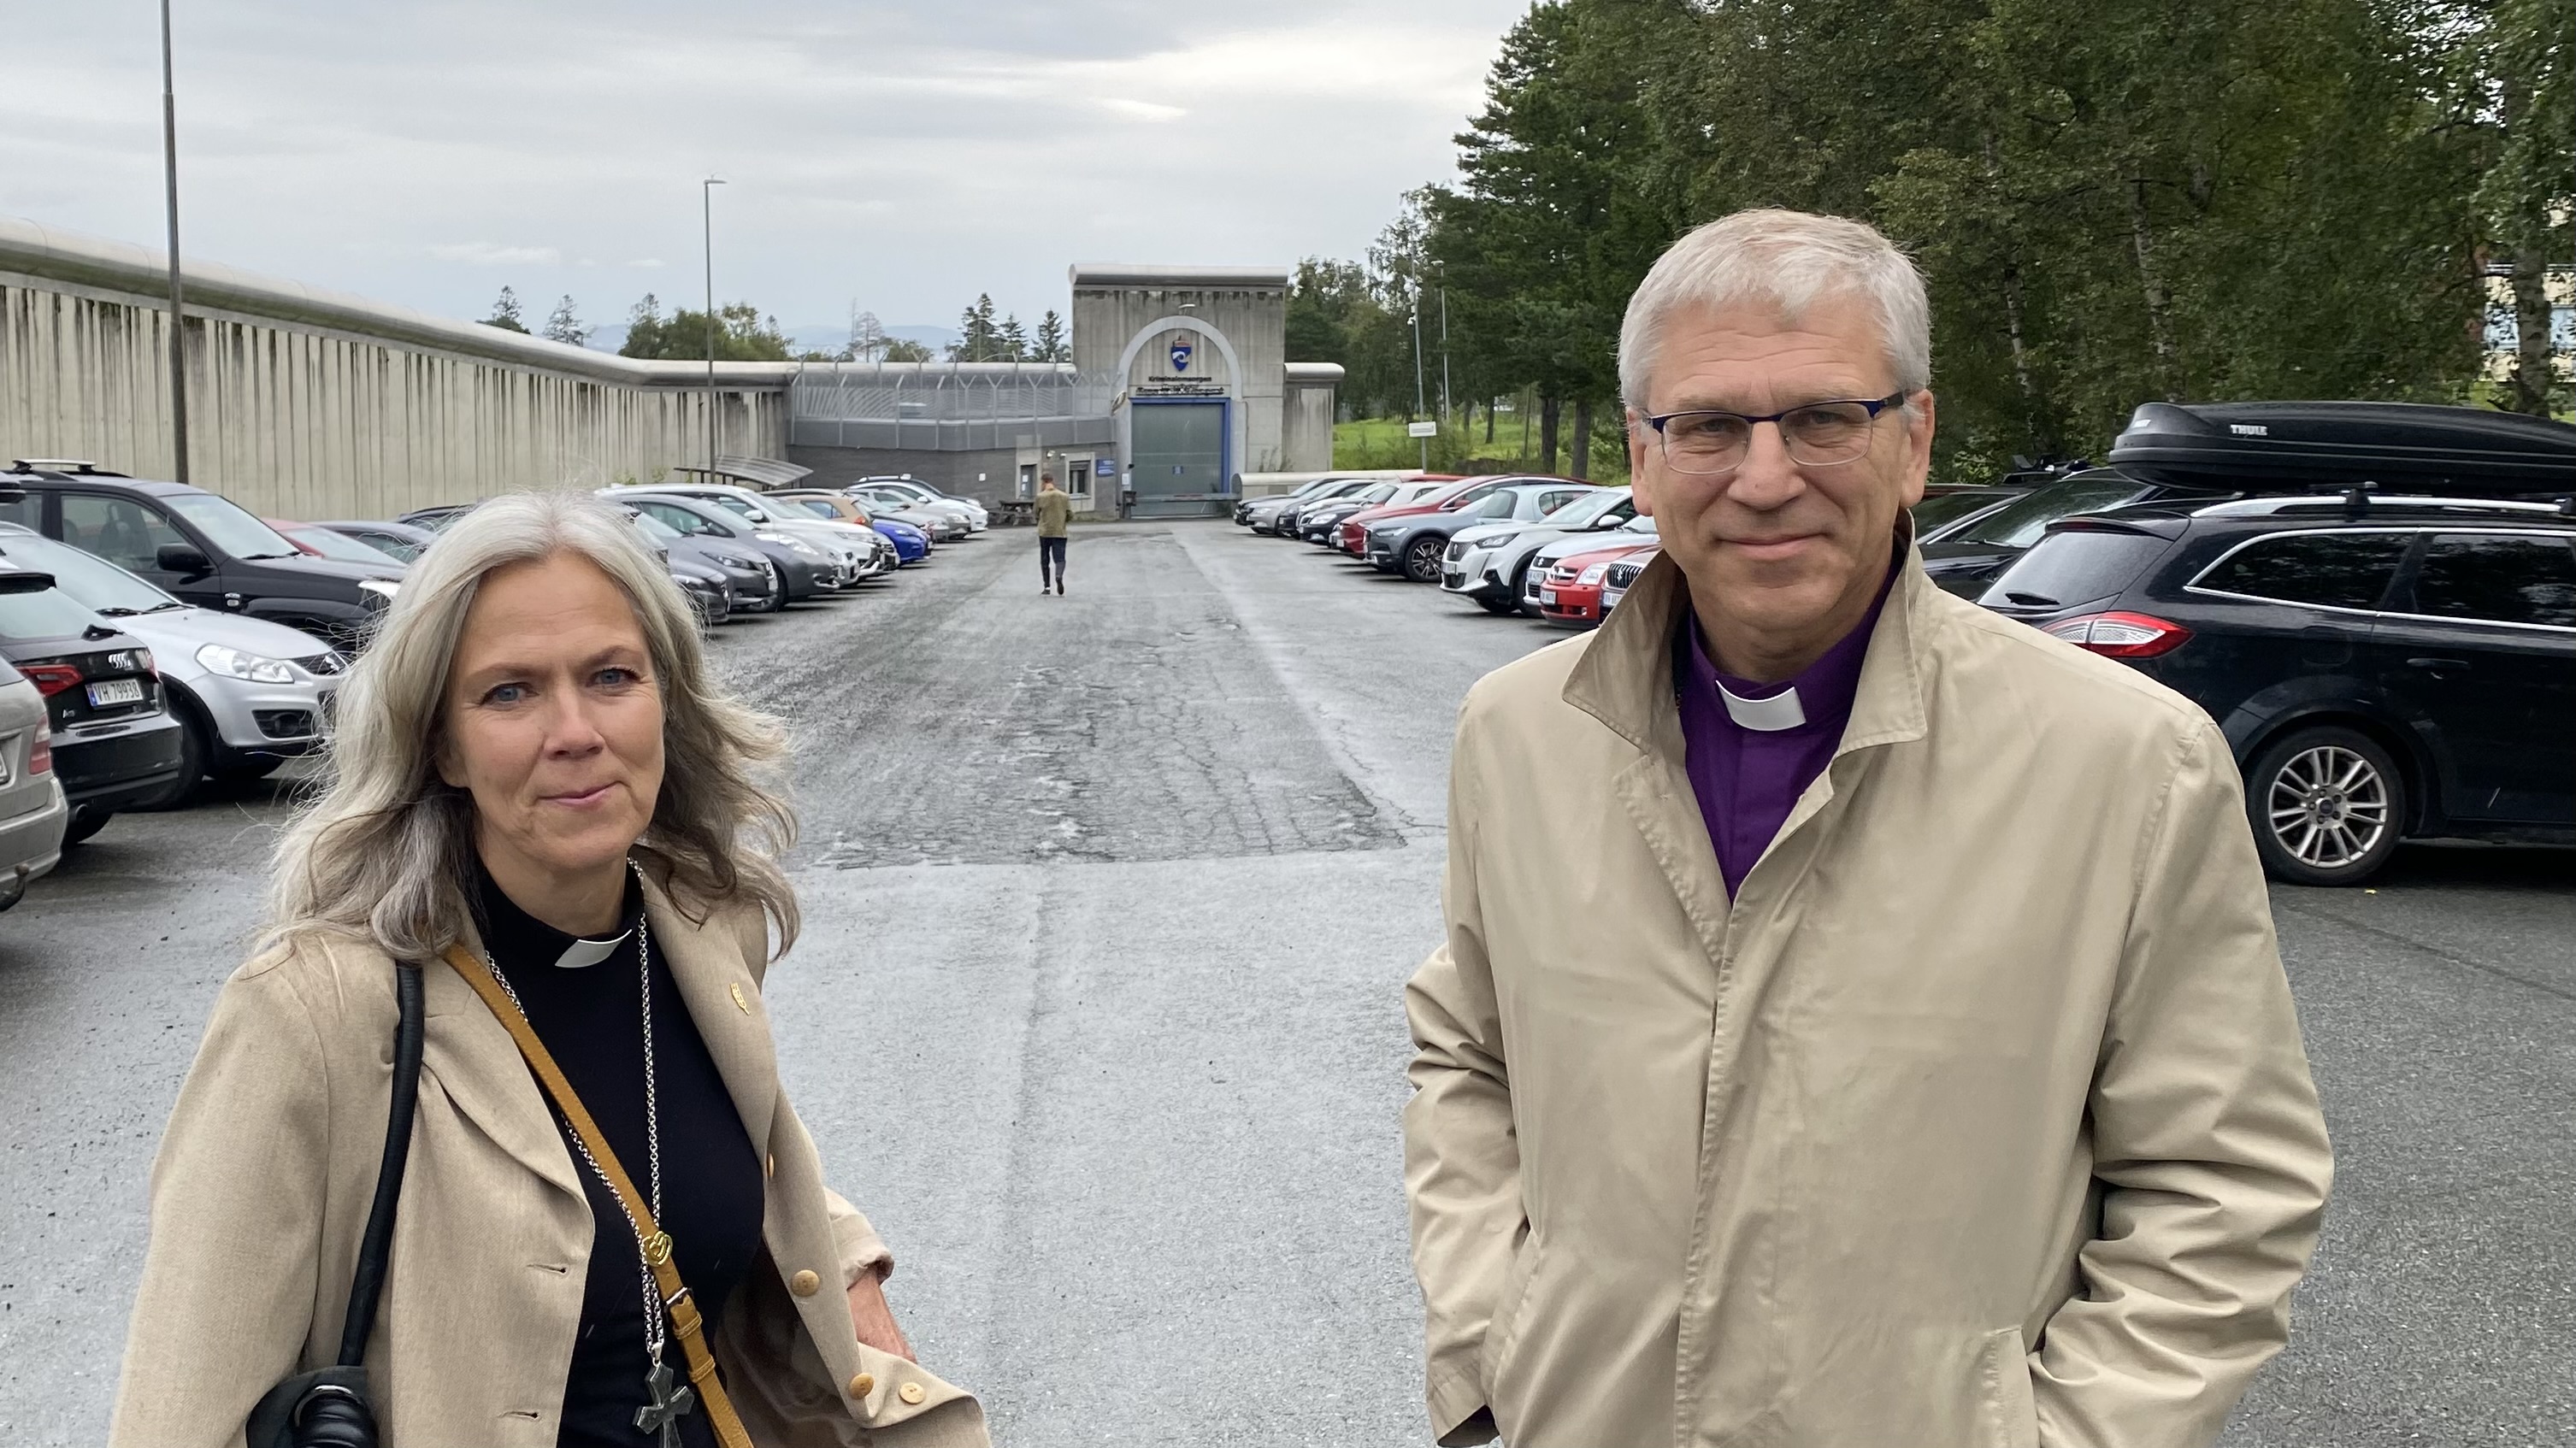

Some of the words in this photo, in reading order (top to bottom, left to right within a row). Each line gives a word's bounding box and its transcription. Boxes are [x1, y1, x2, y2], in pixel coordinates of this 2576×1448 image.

[2230, 424, 2268, 436] THULE
[94, 684, 109, 702] VH
[111, 682, 140, 700] 79938
